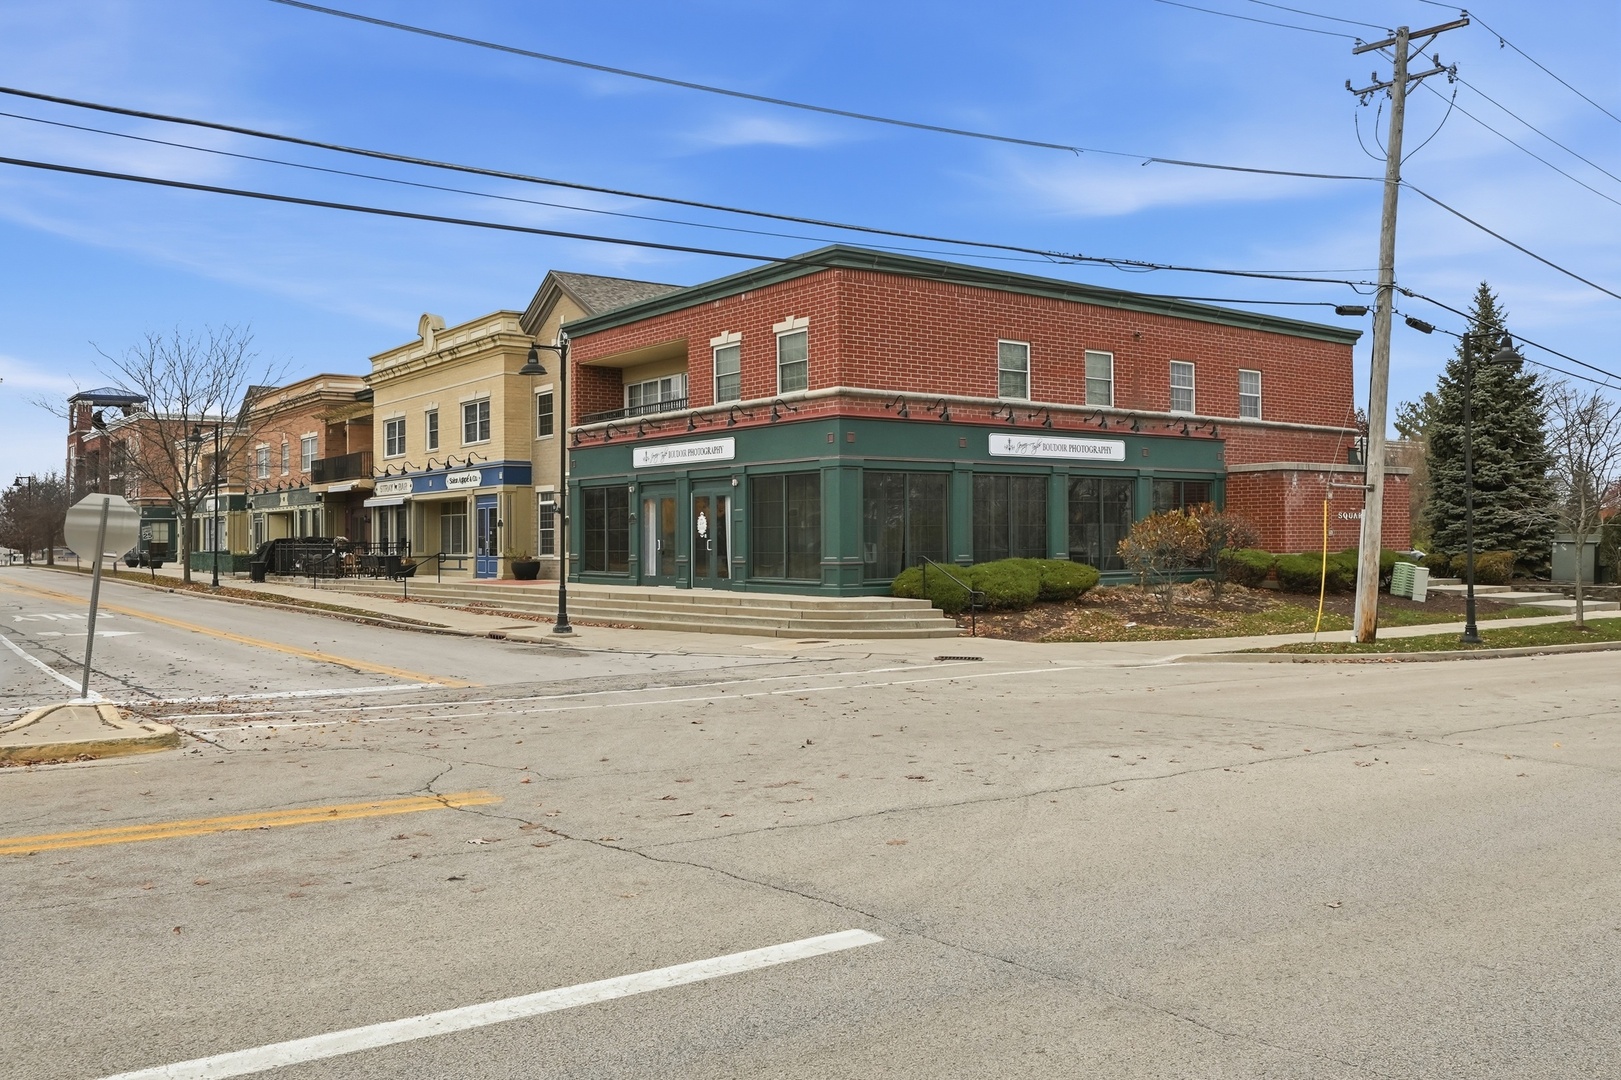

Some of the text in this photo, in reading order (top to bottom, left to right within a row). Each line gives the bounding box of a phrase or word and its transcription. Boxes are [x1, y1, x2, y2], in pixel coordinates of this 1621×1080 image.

[687, 445, 724, 457] PHOTOGRAPHY
[1042, 442, 1068, 452] BOUDOIR
[1068, 444, 1113, 454] PHOTOGRAPHY
